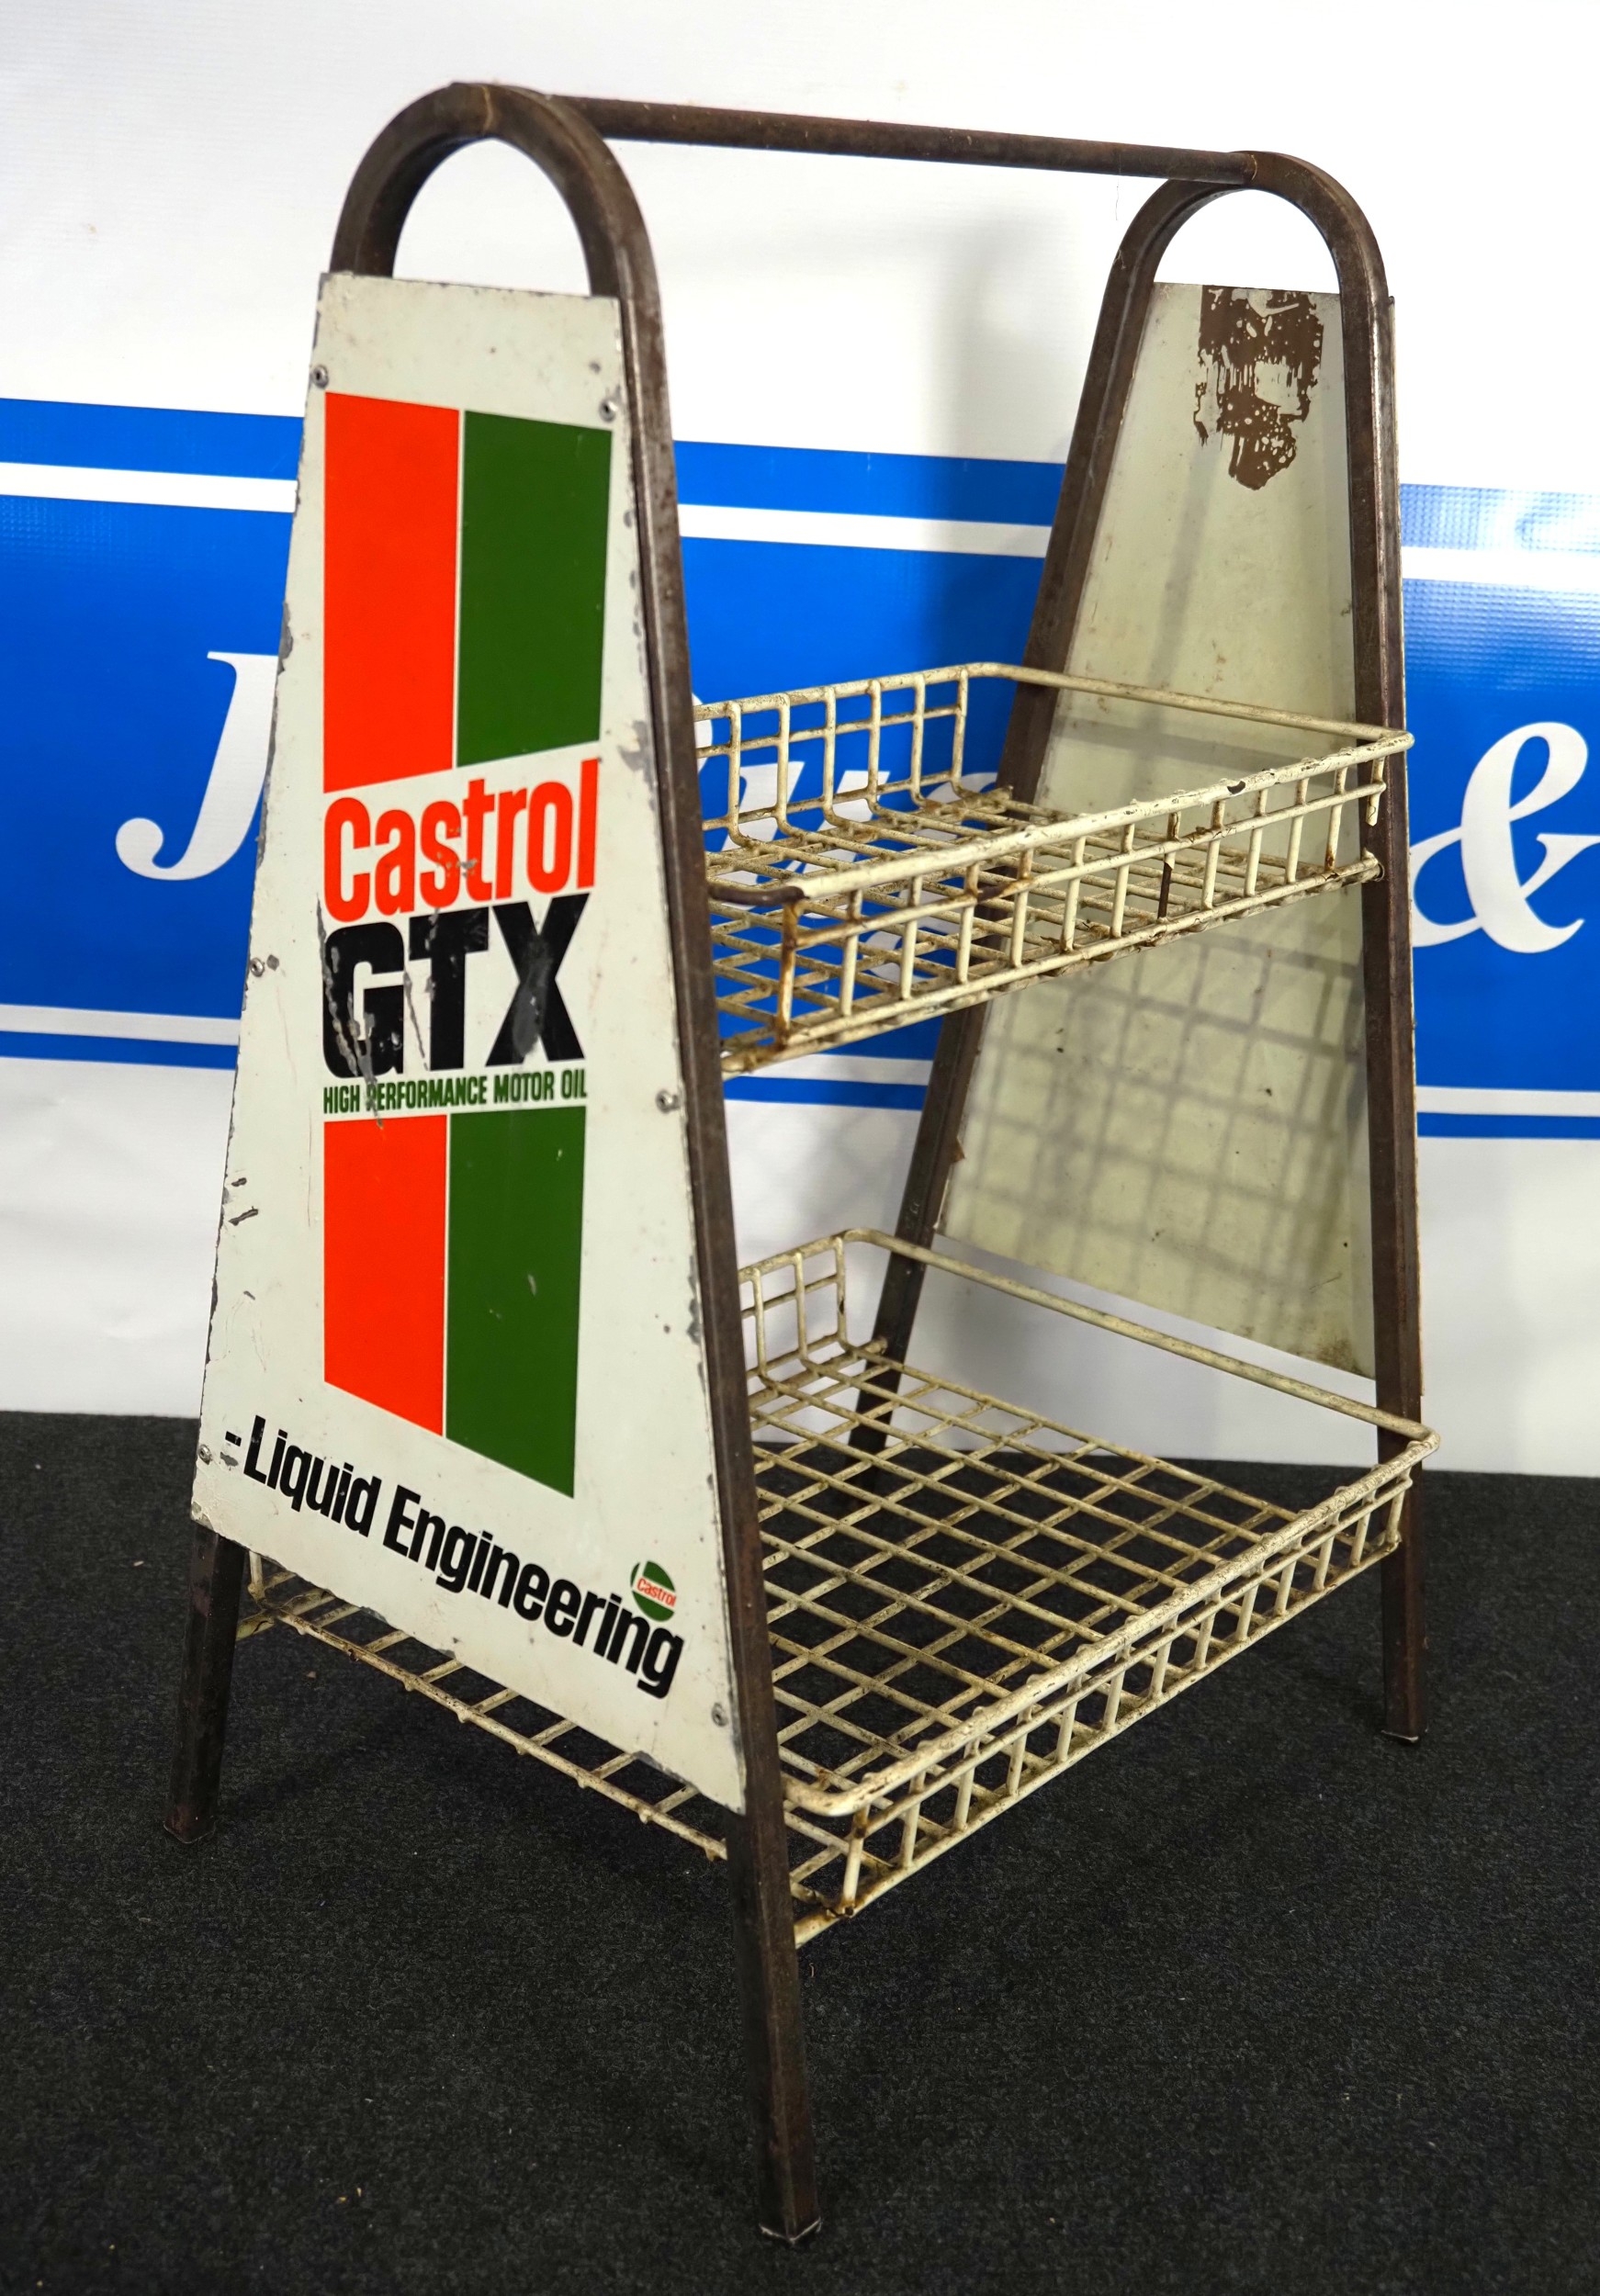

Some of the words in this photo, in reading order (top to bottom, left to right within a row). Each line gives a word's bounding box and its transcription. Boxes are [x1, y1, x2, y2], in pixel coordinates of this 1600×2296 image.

[323, 758, 600, 923] Castrol
[322, 892, 591, 1079] GTX
[322, 1084, 361, 1114] HIGH
[366, 1075, 488, 1111] PERFORMANCE
[493, 1071, 555, 1103] MOTOR
[560, 1068, 588, 1099] OIL
[382, 1484, 685, 1699] Engineering
[637, 1577, 677, 1607] Castrol
